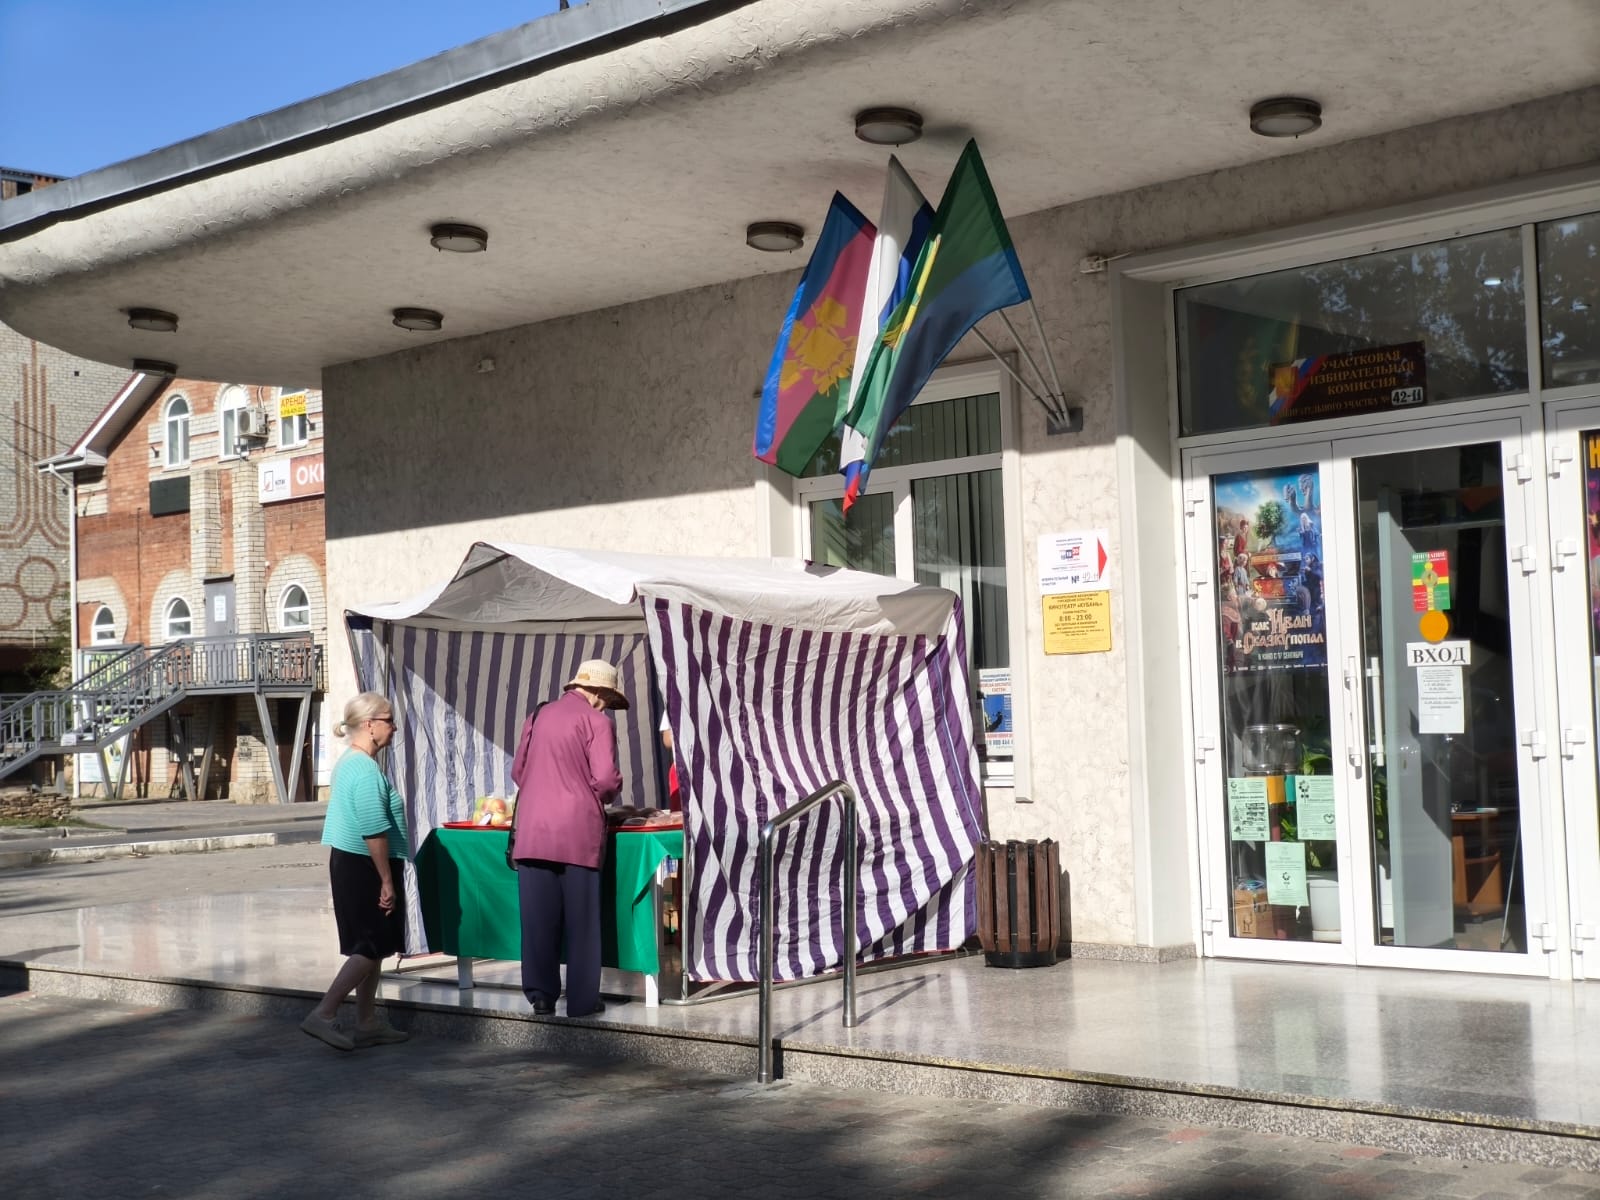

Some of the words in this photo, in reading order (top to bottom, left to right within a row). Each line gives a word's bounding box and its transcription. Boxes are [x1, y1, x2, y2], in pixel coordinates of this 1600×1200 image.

[1322, 350, 1401, 370] УЧАСТКОВАЯ
[1310, 360, 1415, 385] ИЗБИРАТЕЛЬНАЯ
[1327, 376, 1398, 396] КОМИССИЯ
[1412, 646, 1466, 664] ВХОД
